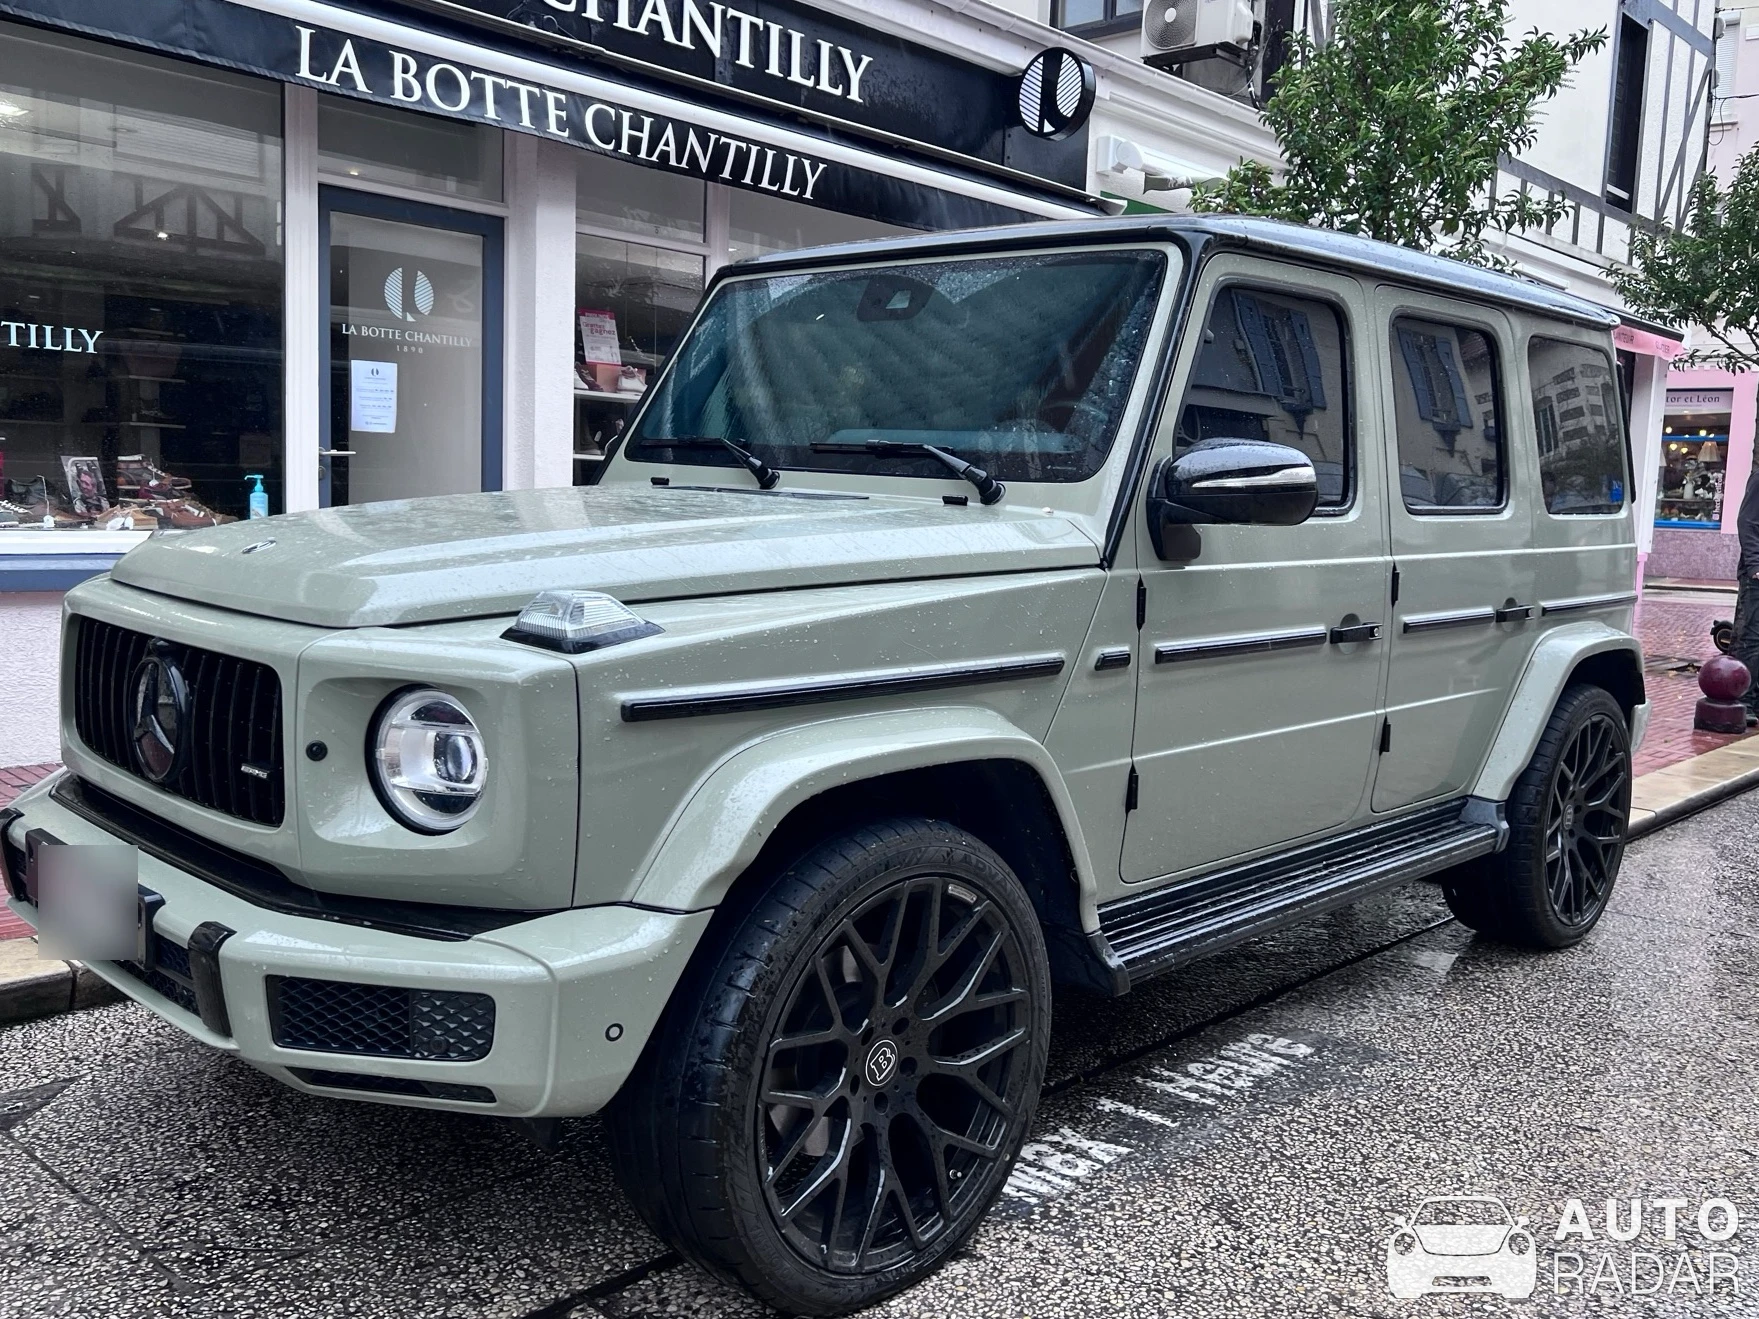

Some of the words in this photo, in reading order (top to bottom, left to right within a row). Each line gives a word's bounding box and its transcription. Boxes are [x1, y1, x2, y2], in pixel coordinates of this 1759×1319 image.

[543, 0, 873, 103] ANTILLY
[295, 25, 373, 94] LA
[388, 50, 570, 138] BOTTE
[584, 103, 827, 200] CHANTILLY
[0, 320, 104, 354] TILLY
[342, 323, 358, 336] LA
[361, 325, 402, 340] BOTTE
[404, 330, 473, 348] CHANTILLY
[396, 344, 424, 354] 1890
[1684, 395, 1693, 403] et
[1696, 393, 1721, 404] Léon
